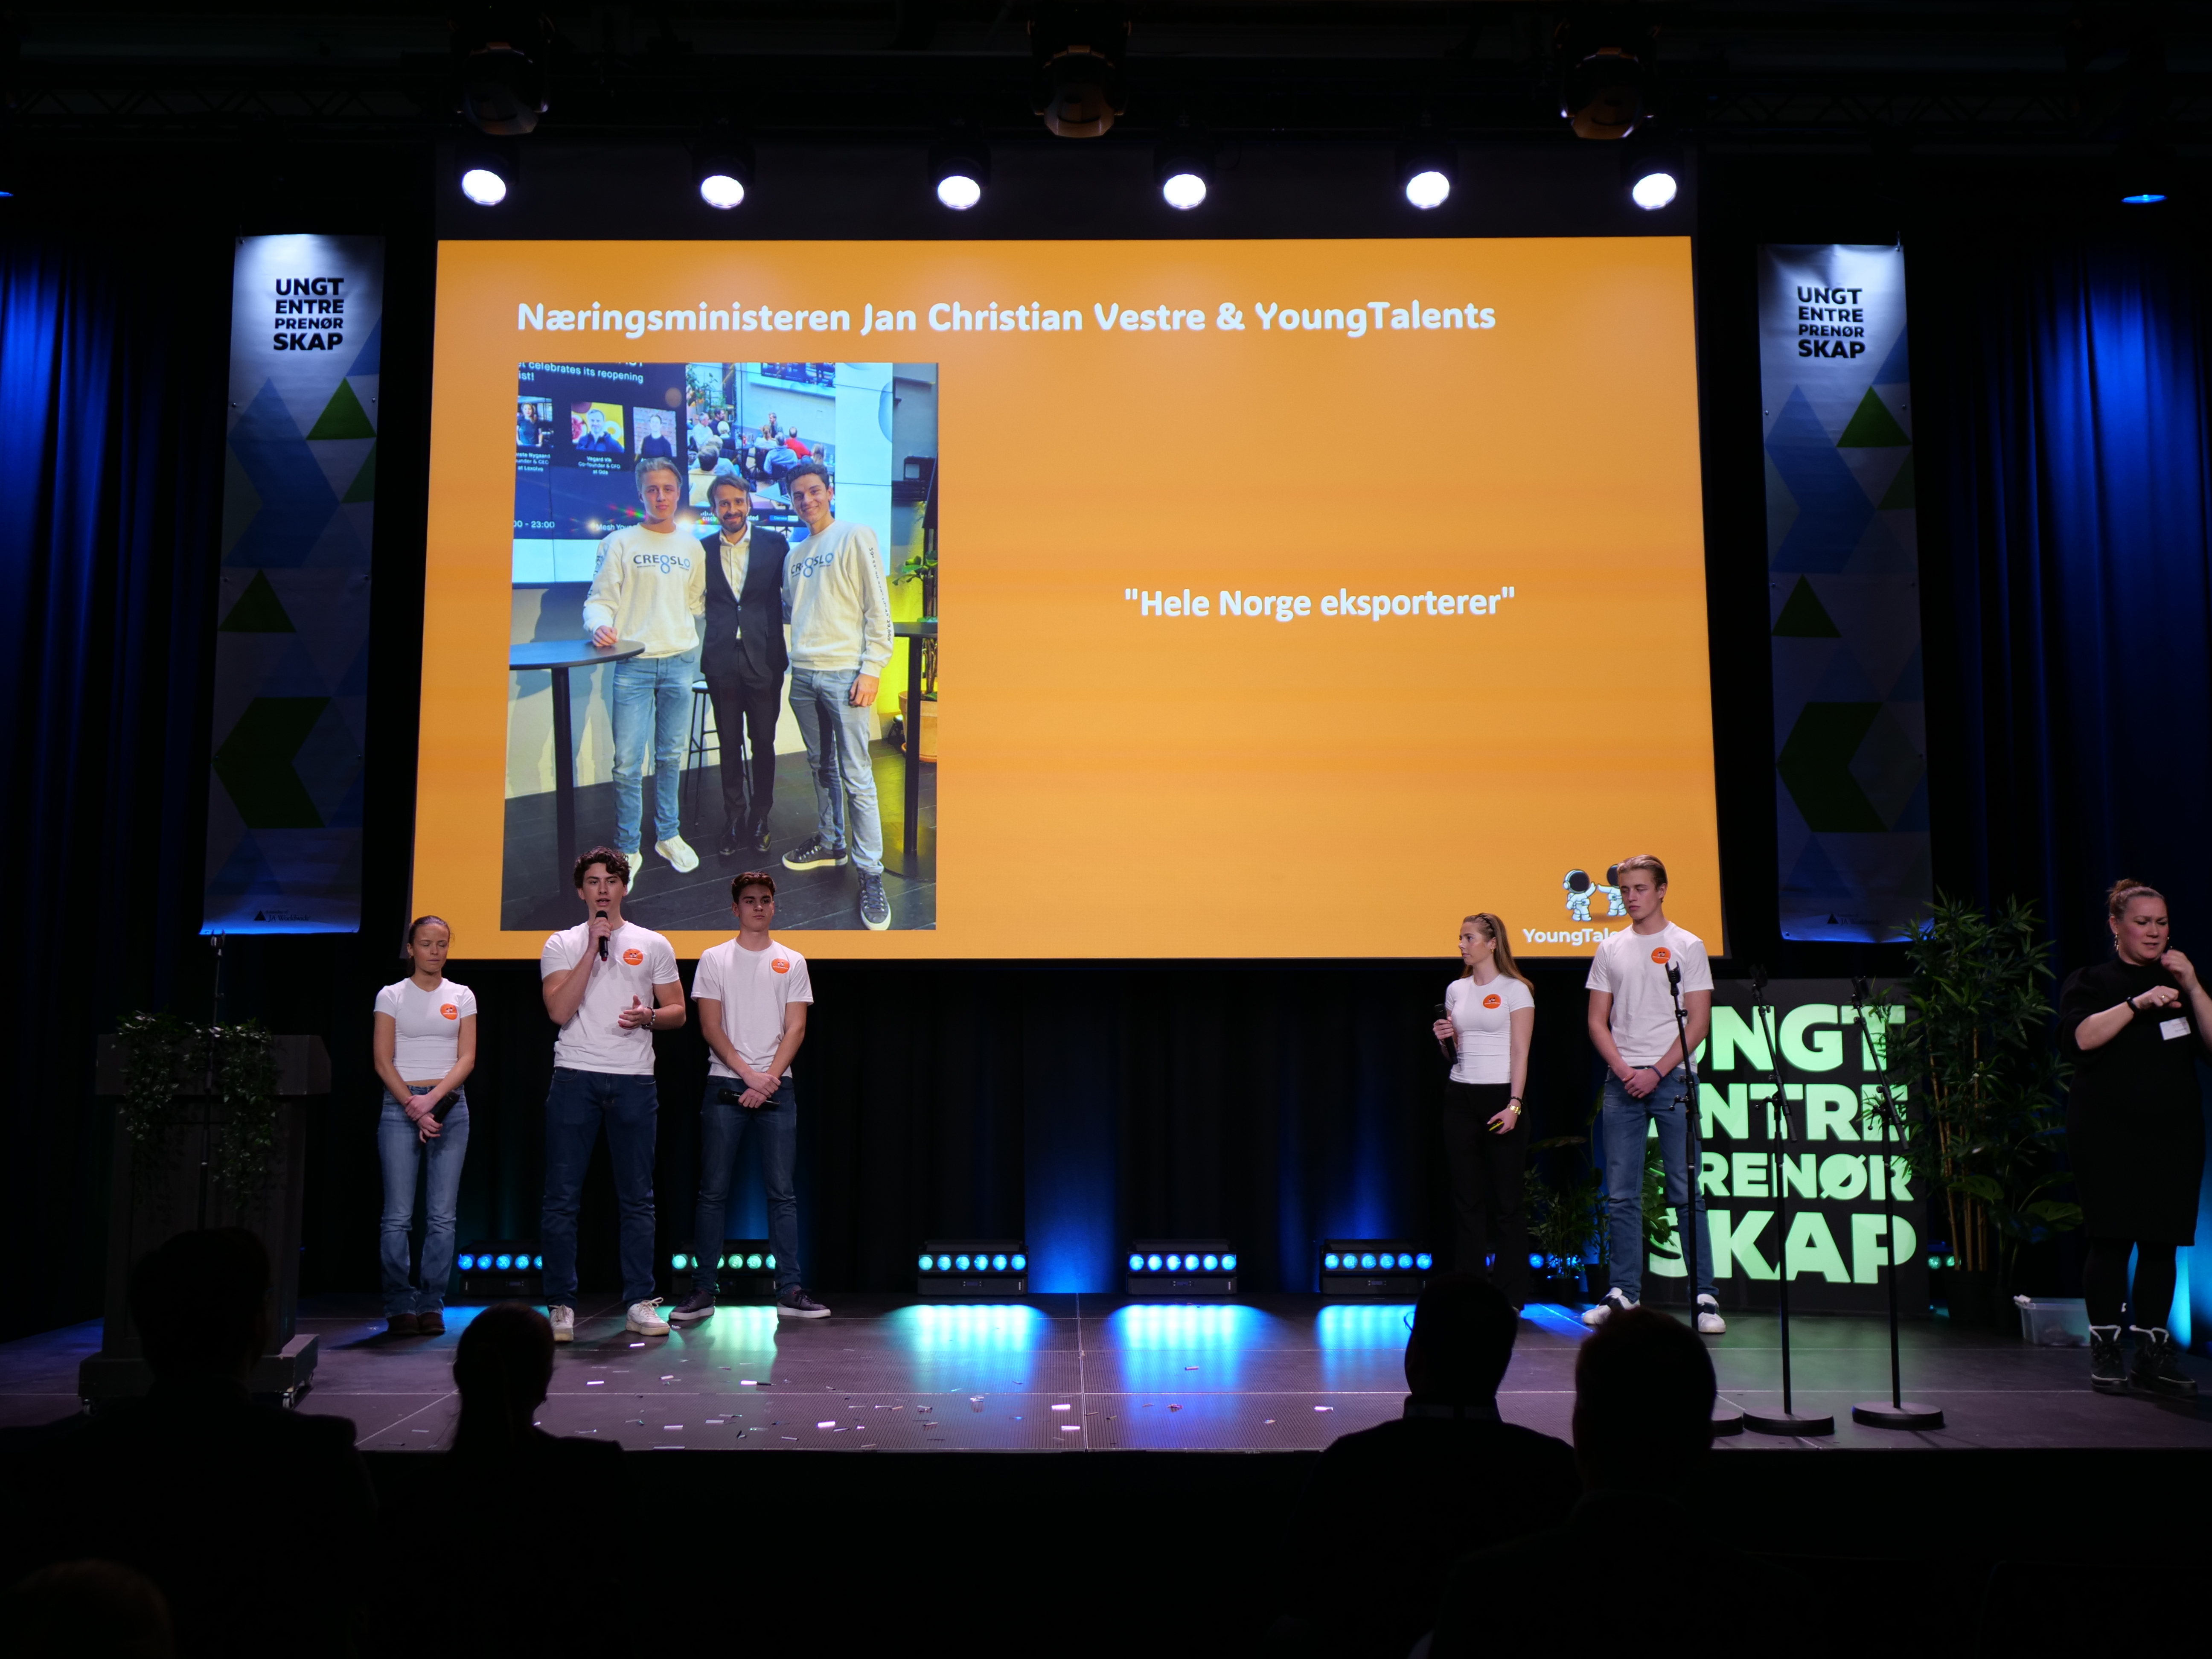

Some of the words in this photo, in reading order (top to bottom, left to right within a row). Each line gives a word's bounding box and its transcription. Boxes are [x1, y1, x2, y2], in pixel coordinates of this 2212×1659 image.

[276, 277, 344, 295] UNGT
[1798, 286, 1863, 304] UNGT
[276, 299, 344, 314] ENTRE
[1799, 306, 1863, 322] ENTRE
[275, 317, 344, 329] PRENØR
[518, 301, 850, 339] Næringsministeren
[860, 303, 917, 337] Jan
[928, 301, 1083, 332] Christian
[1093, 303, 1206, 332] Vestre
[1216, 302, 1246, 331] &
[1254, 299, 1496, 338] YoungTalents
[1799, 323, 1864, 337] PRENØR
[274, 332, 343, 350] SKAP
[1798, 338, 1865, 358] SKAP
[528, 362, 581, 374] celebrates
[583, 367, 596, 376] its
[597, 370, 643, 384] reopening
[1124, 588, 1210, 617] "Hele
[1219, 591, 1312, 623] Norge
[1320, 586, 1515, 622] eksporterer"
[1696, 1004, 1906, 1072] NGT
